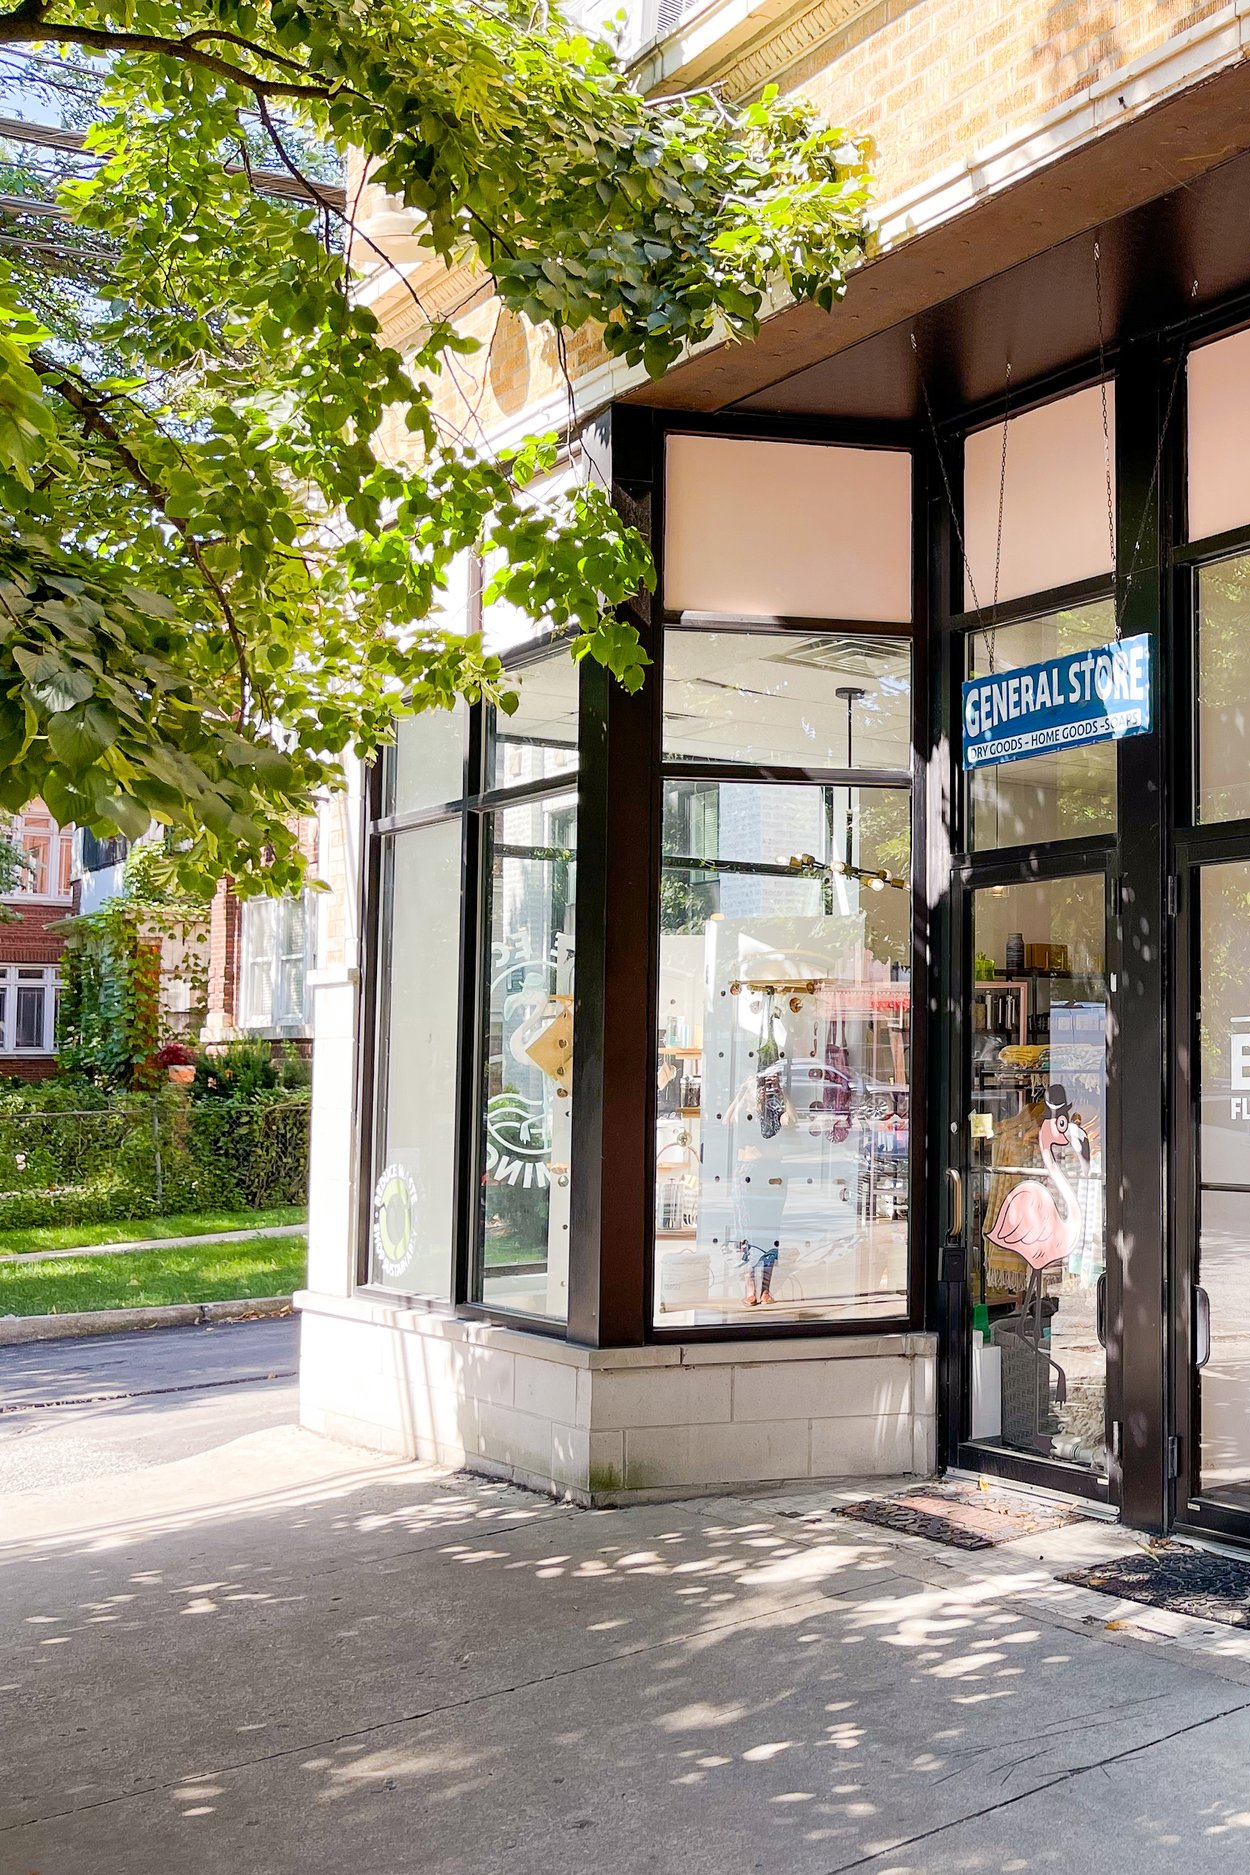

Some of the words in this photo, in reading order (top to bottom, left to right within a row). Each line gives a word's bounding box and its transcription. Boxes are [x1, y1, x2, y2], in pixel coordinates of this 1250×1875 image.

[965, 667, 1064, 738] GENERAL
[1069, 646, 1144, 703] STORE
[971, 746, 988, 760] DRY
[990, 739, 1022, 756] GOODS
[1031, 729, 1060, 746] HOME
[1062, 720, 1098, 742] GOODS
[374, 1163, 398, 1207] REDUCE
